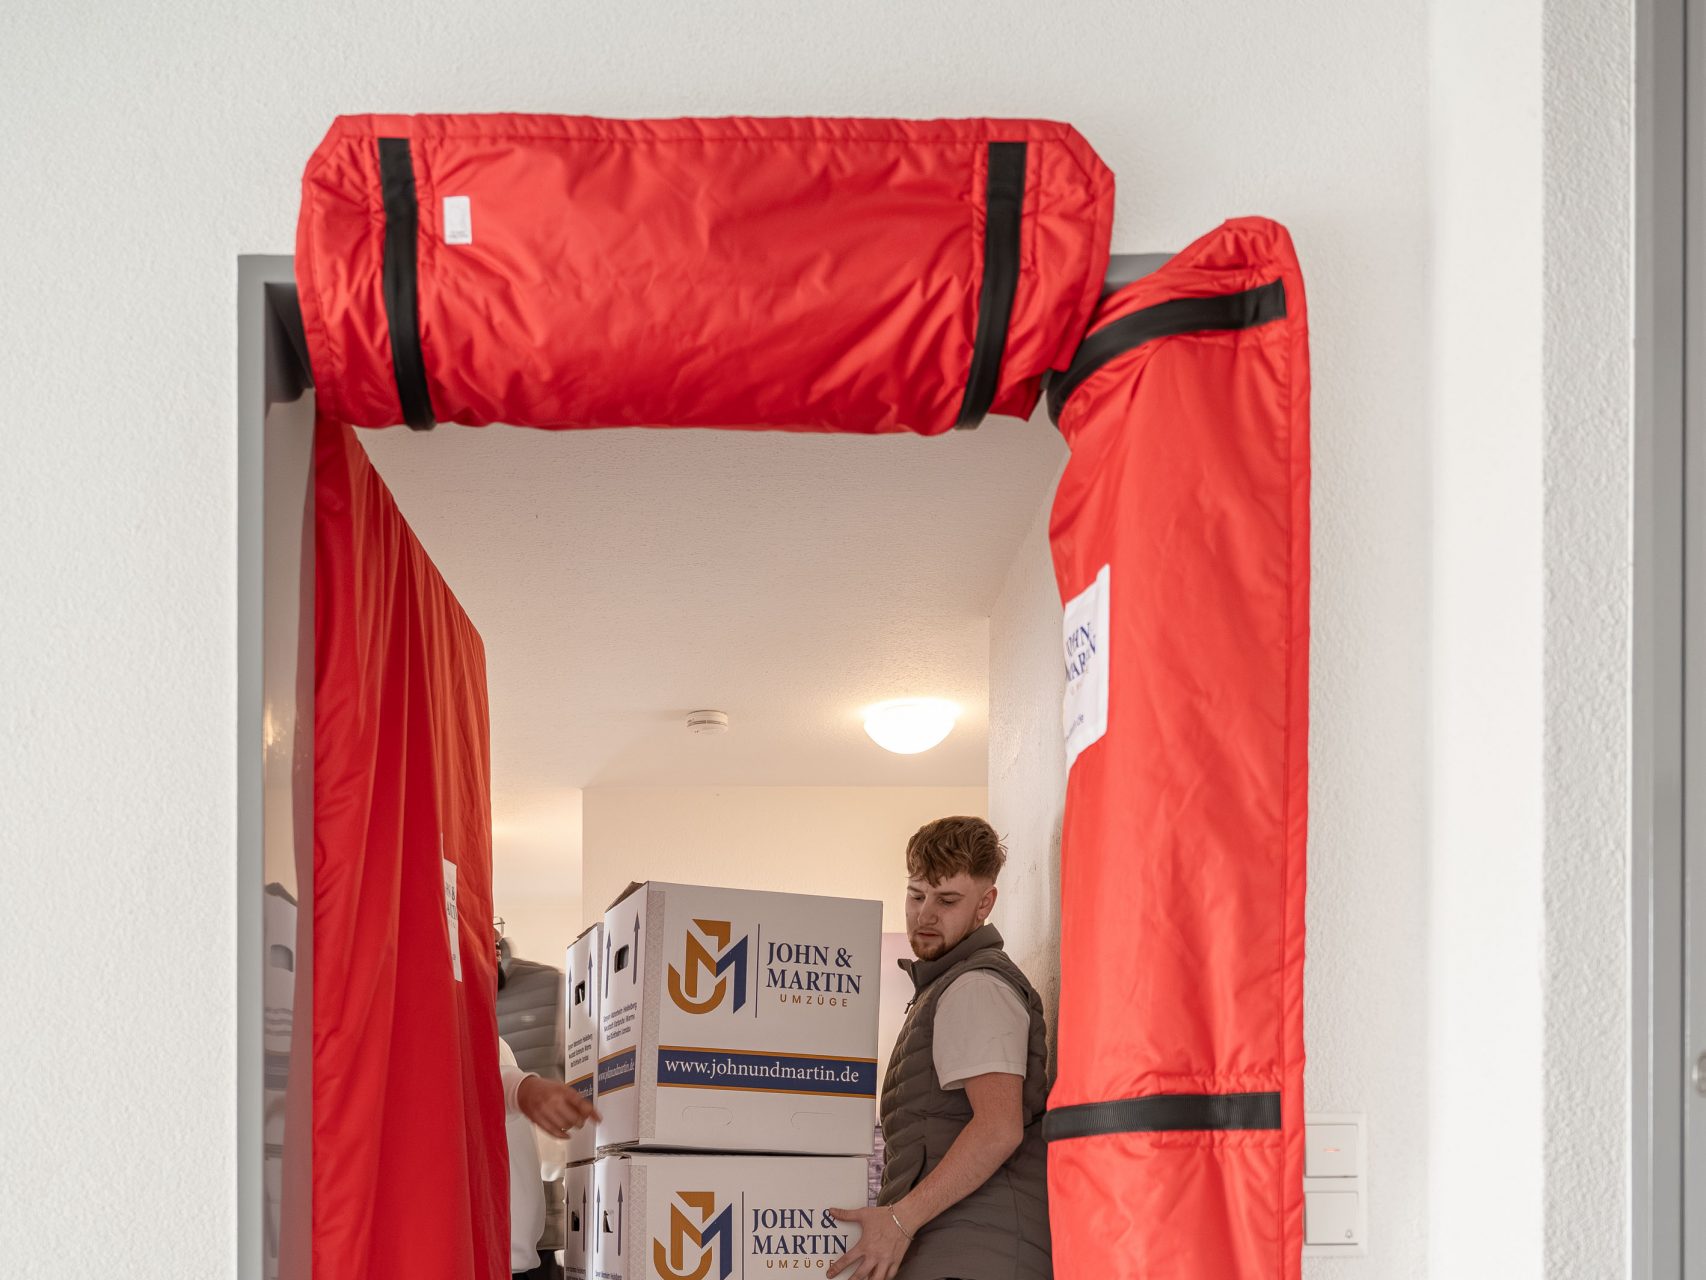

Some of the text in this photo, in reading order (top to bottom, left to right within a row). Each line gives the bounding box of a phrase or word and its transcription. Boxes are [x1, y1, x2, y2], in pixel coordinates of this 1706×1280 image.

[767, 941, 853, 968] JOHN &
[766, 968, 862, 995] MARTIN
[779, 993, 848, 1008] UMZÜGE
[664, 1057, 860, 1083] www.johnundmartin.de
[752, 1208, 838, 1232] JOHN &
[752, 1234, 849, 1255] MARTIN
